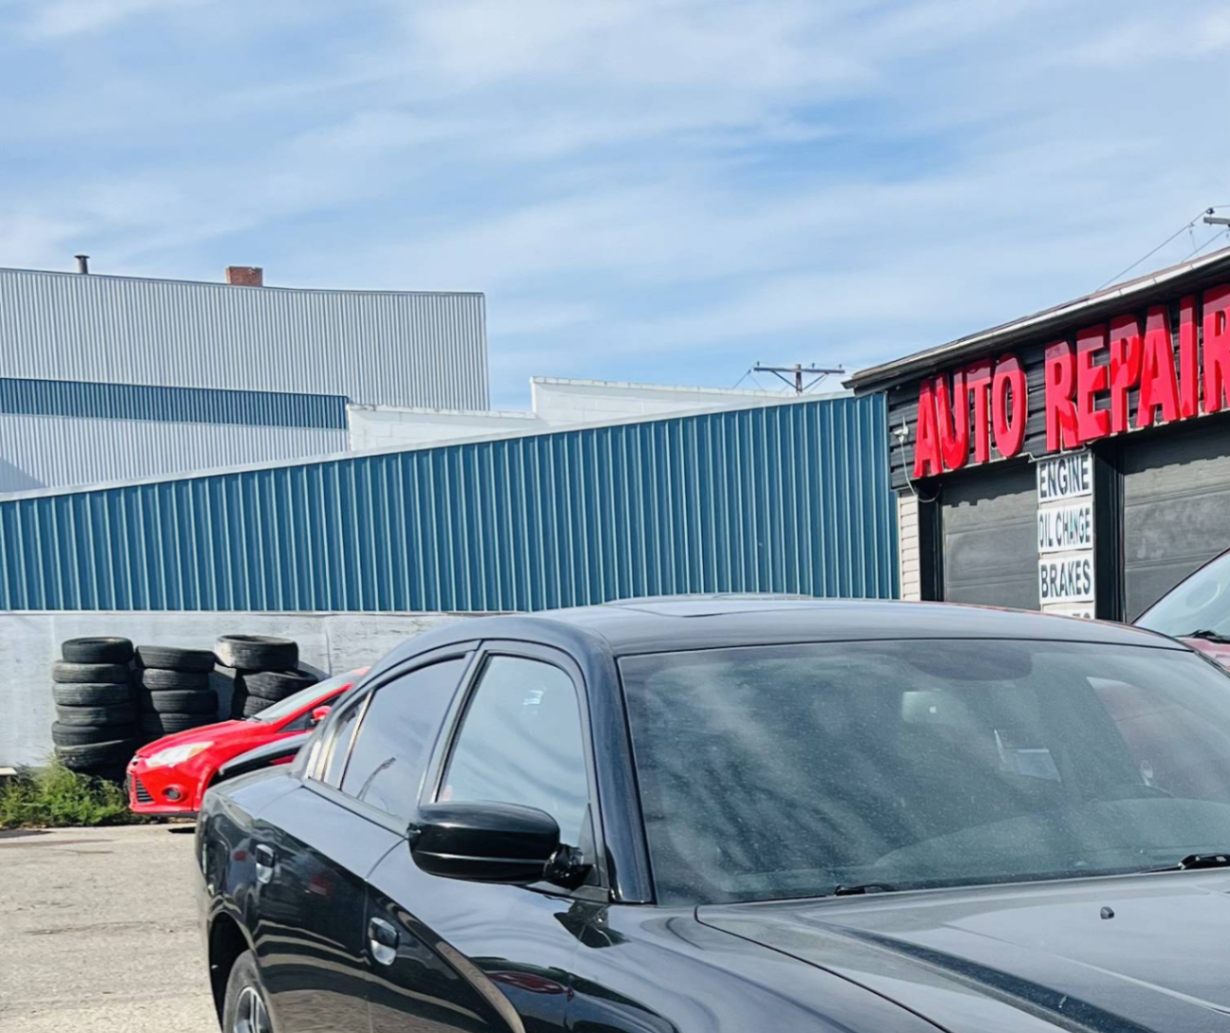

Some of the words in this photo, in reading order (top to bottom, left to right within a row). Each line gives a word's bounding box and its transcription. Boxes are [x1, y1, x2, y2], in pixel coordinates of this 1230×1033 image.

[914, 352, 1028, 479] AUTO
[1039, 454, 1090, 499] ENGINE
[1039, 512, 1053, 548] OIL
[1055, 507, 1090, 547] CHANGE
[1040, 558, 1091, 598] BRAKES
